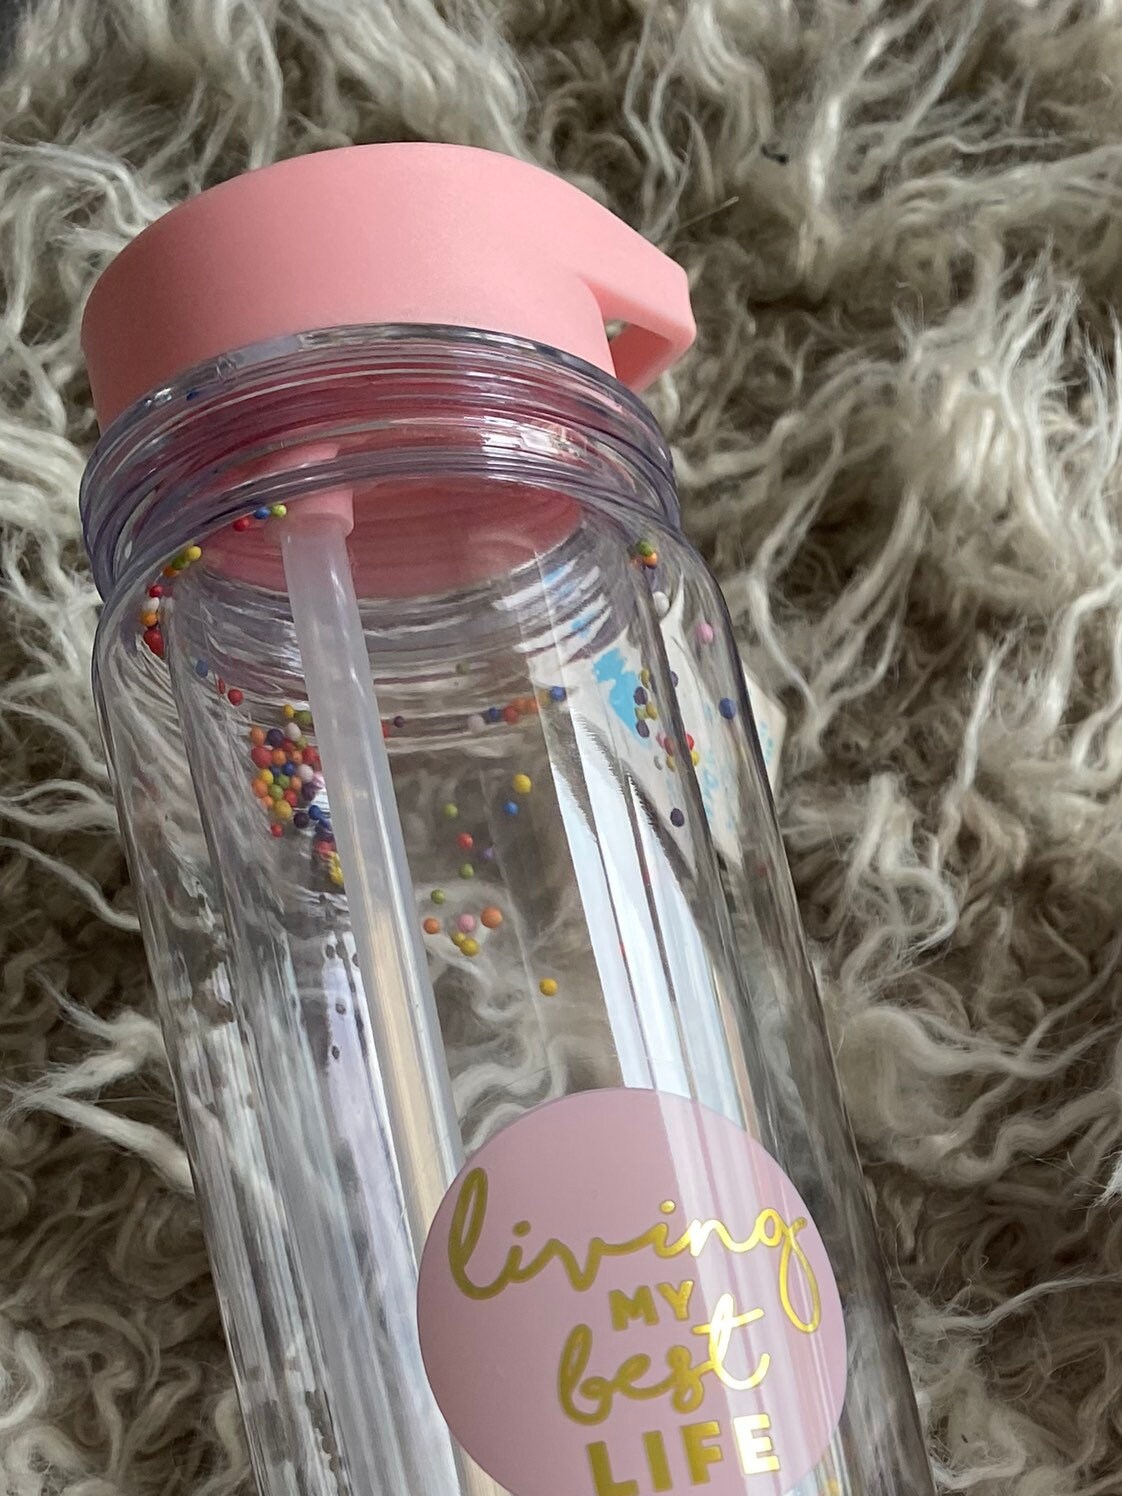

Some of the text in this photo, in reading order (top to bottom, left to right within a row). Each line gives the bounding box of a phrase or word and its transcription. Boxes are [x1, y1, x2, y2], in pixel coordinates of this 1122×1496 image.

[447, 1166, 822, 1334] living
[608, 1279, 694, 1332] MY
[557, 1292, 771, 1426] best
